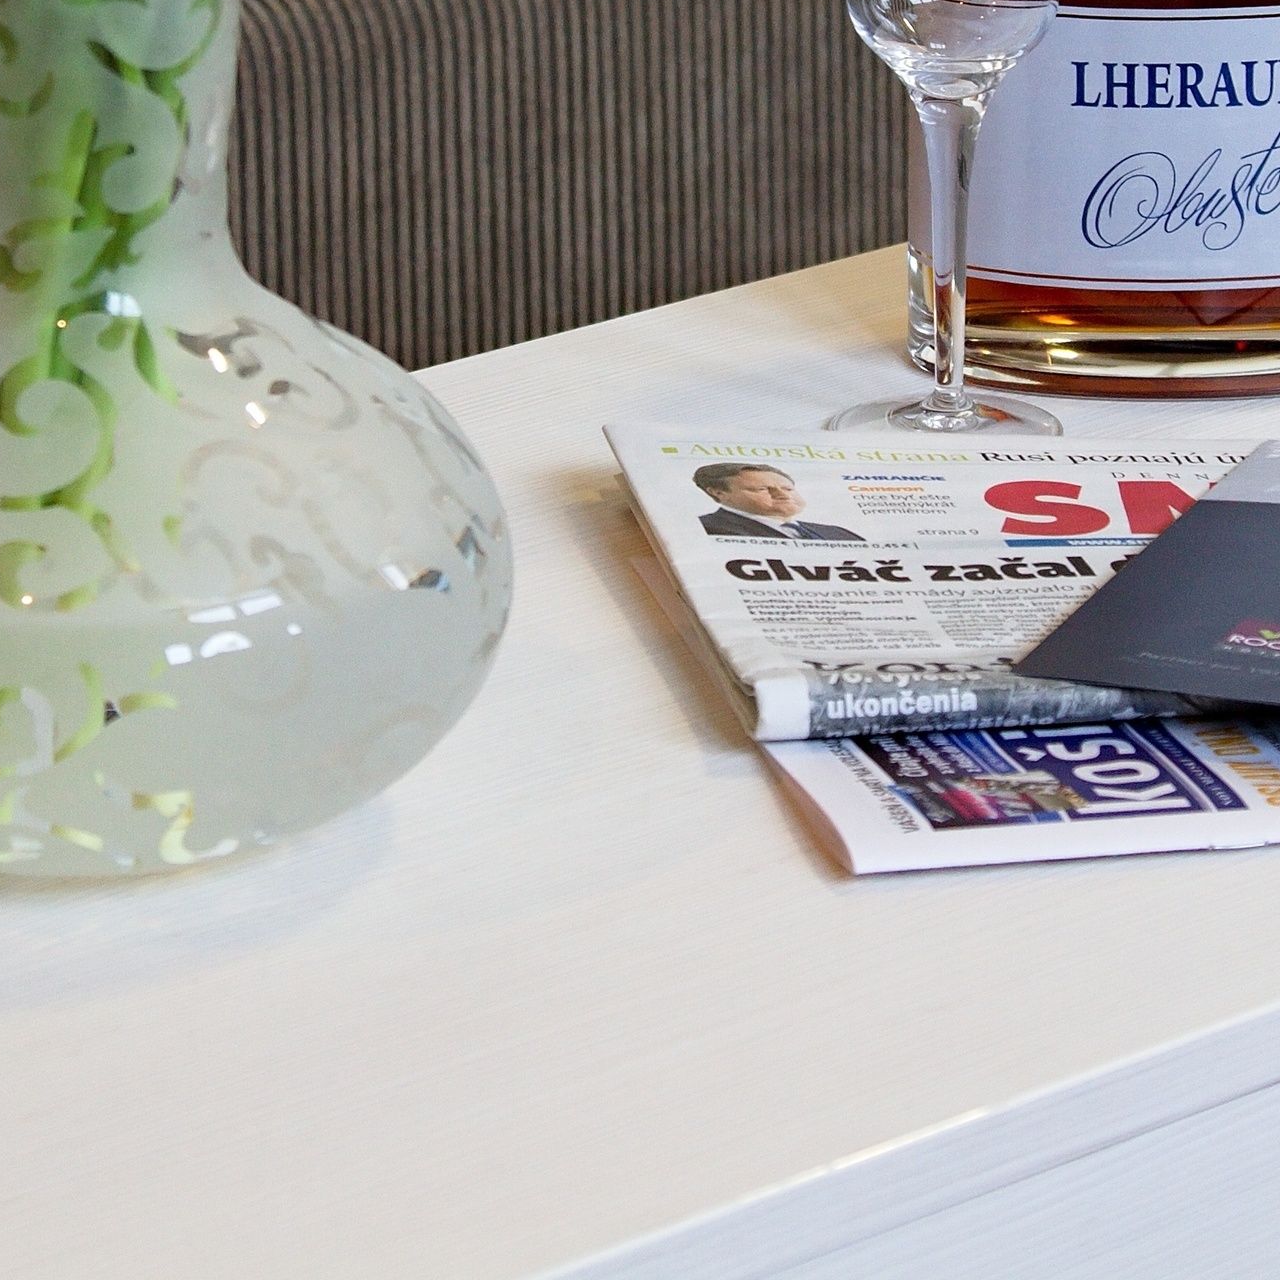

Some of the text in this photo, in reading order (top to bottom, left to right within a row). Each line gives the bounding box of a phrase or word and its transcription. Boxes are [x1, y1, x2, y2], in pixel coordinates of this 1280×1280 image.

[690, 442, 846, 461] Autorská
[856, 448, 969, 462] strana
[980, 450, 1056, 463] Rusi
[1068, 451, 1205, 466] poznajú
[917, 528, 967, 536] strana
[724, 558, 912, 583] Glváč
[923, 556, 1096, 582] začal
[738, 588, 878, 598] Posilňovanie
[884, 587, 966, 598] armády
[827, 687, 979, 719] ukončenia
